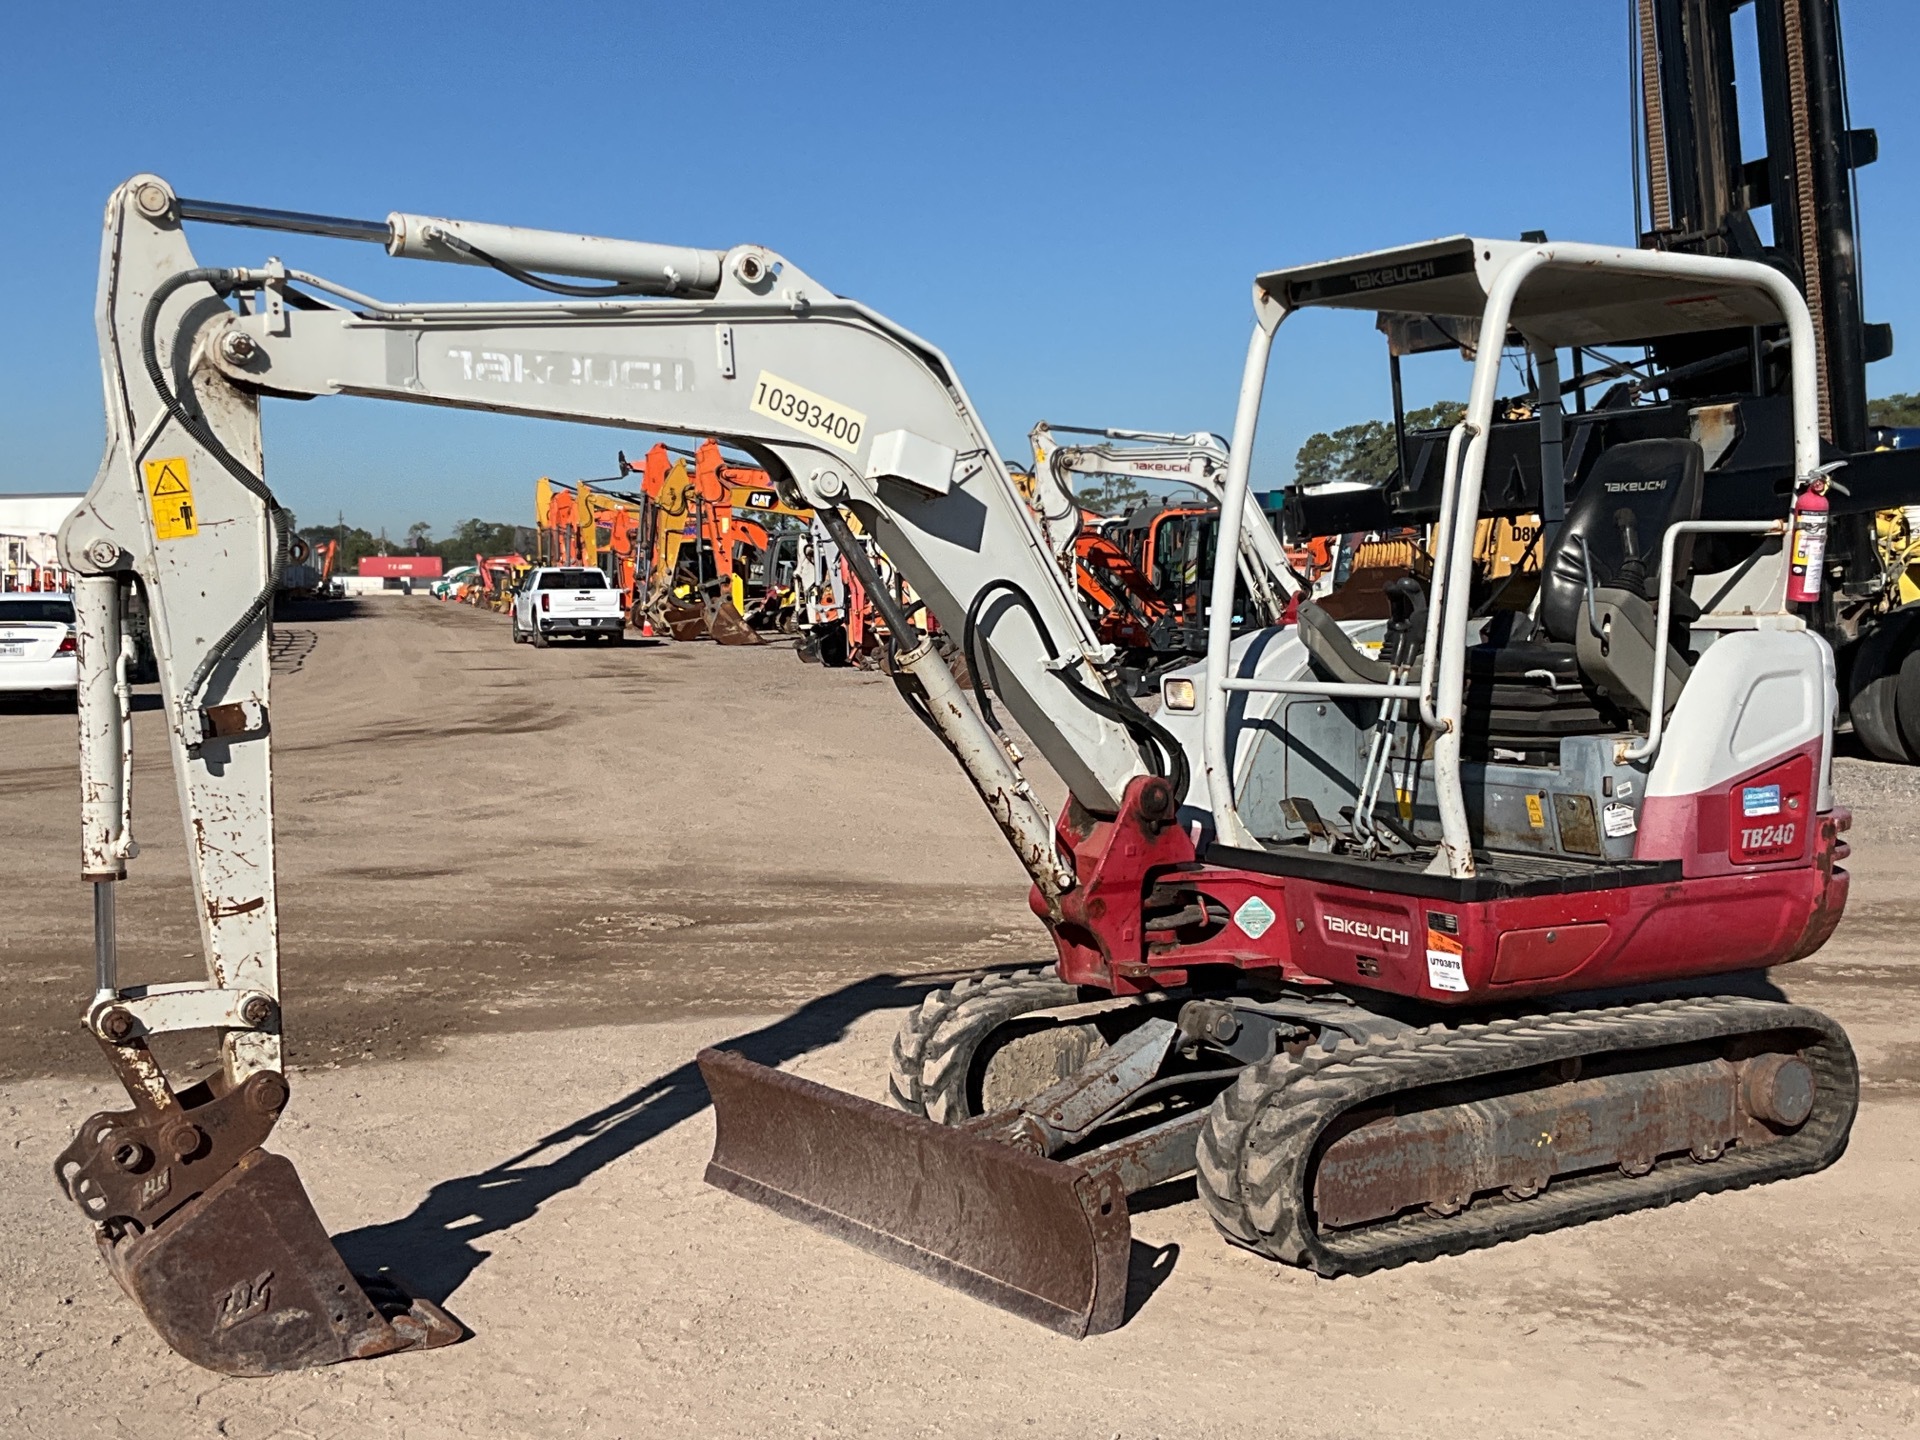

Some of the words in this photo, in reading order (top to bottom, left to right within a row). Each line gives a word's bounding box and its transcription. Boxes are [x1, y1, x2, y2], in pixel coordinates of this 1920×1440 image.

[1349, 261, 1435, 290] TAKEUCHI
[758, 382, 861, 445] 10393400
[1133, 462, 1191, 473] TAKEUCHI
[751, 493, 771, 507] CAT
[1604, 479, 1667, 493] TAKEUCHI
[1741, 822, 1796, 850] TB240
[1323, 915, 1409, 946] TAKEUCHI
